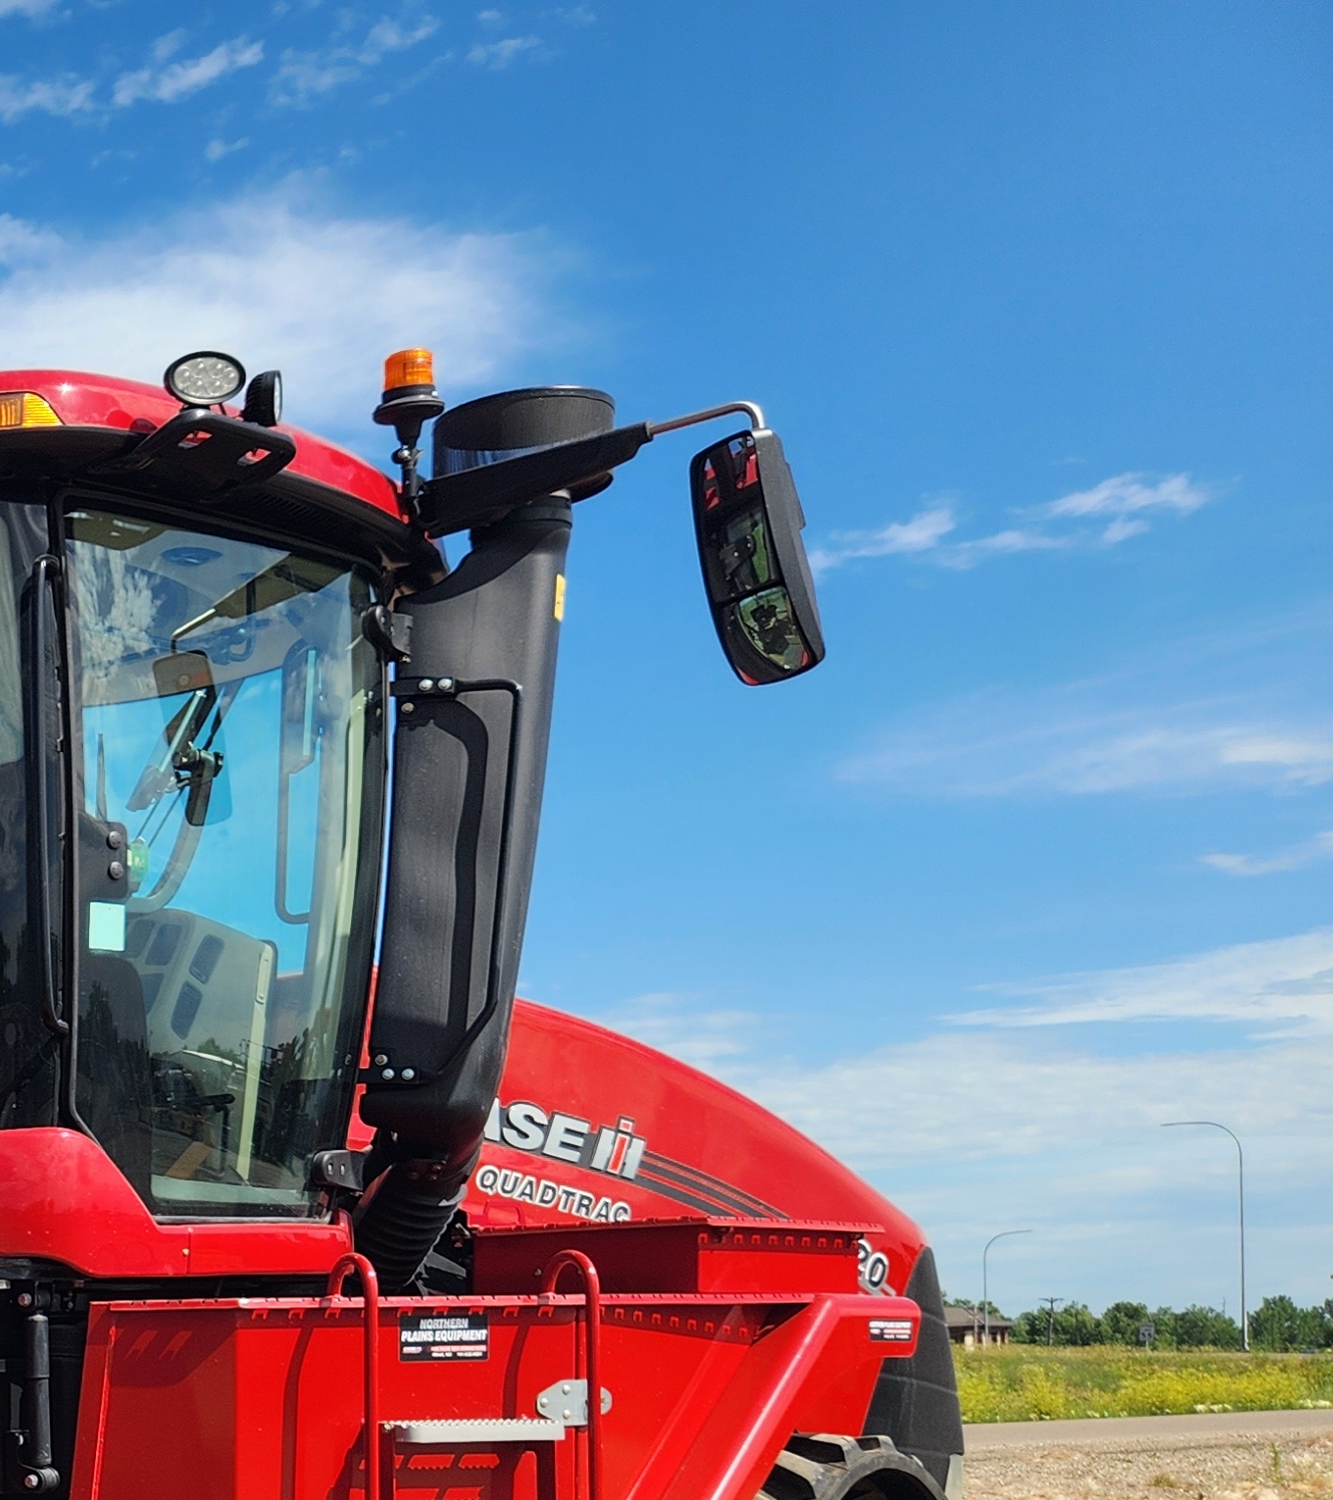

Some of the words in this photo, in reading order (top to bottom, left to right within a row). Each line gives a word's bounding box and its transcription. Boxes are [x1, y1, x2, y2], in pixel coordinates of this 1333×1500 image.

[419, 1317, 470, 1330] NORTHERN
[401, 1330, 434, 1342] PLAINS
[434, 1329, 488, 1342] EQUIPMENT
